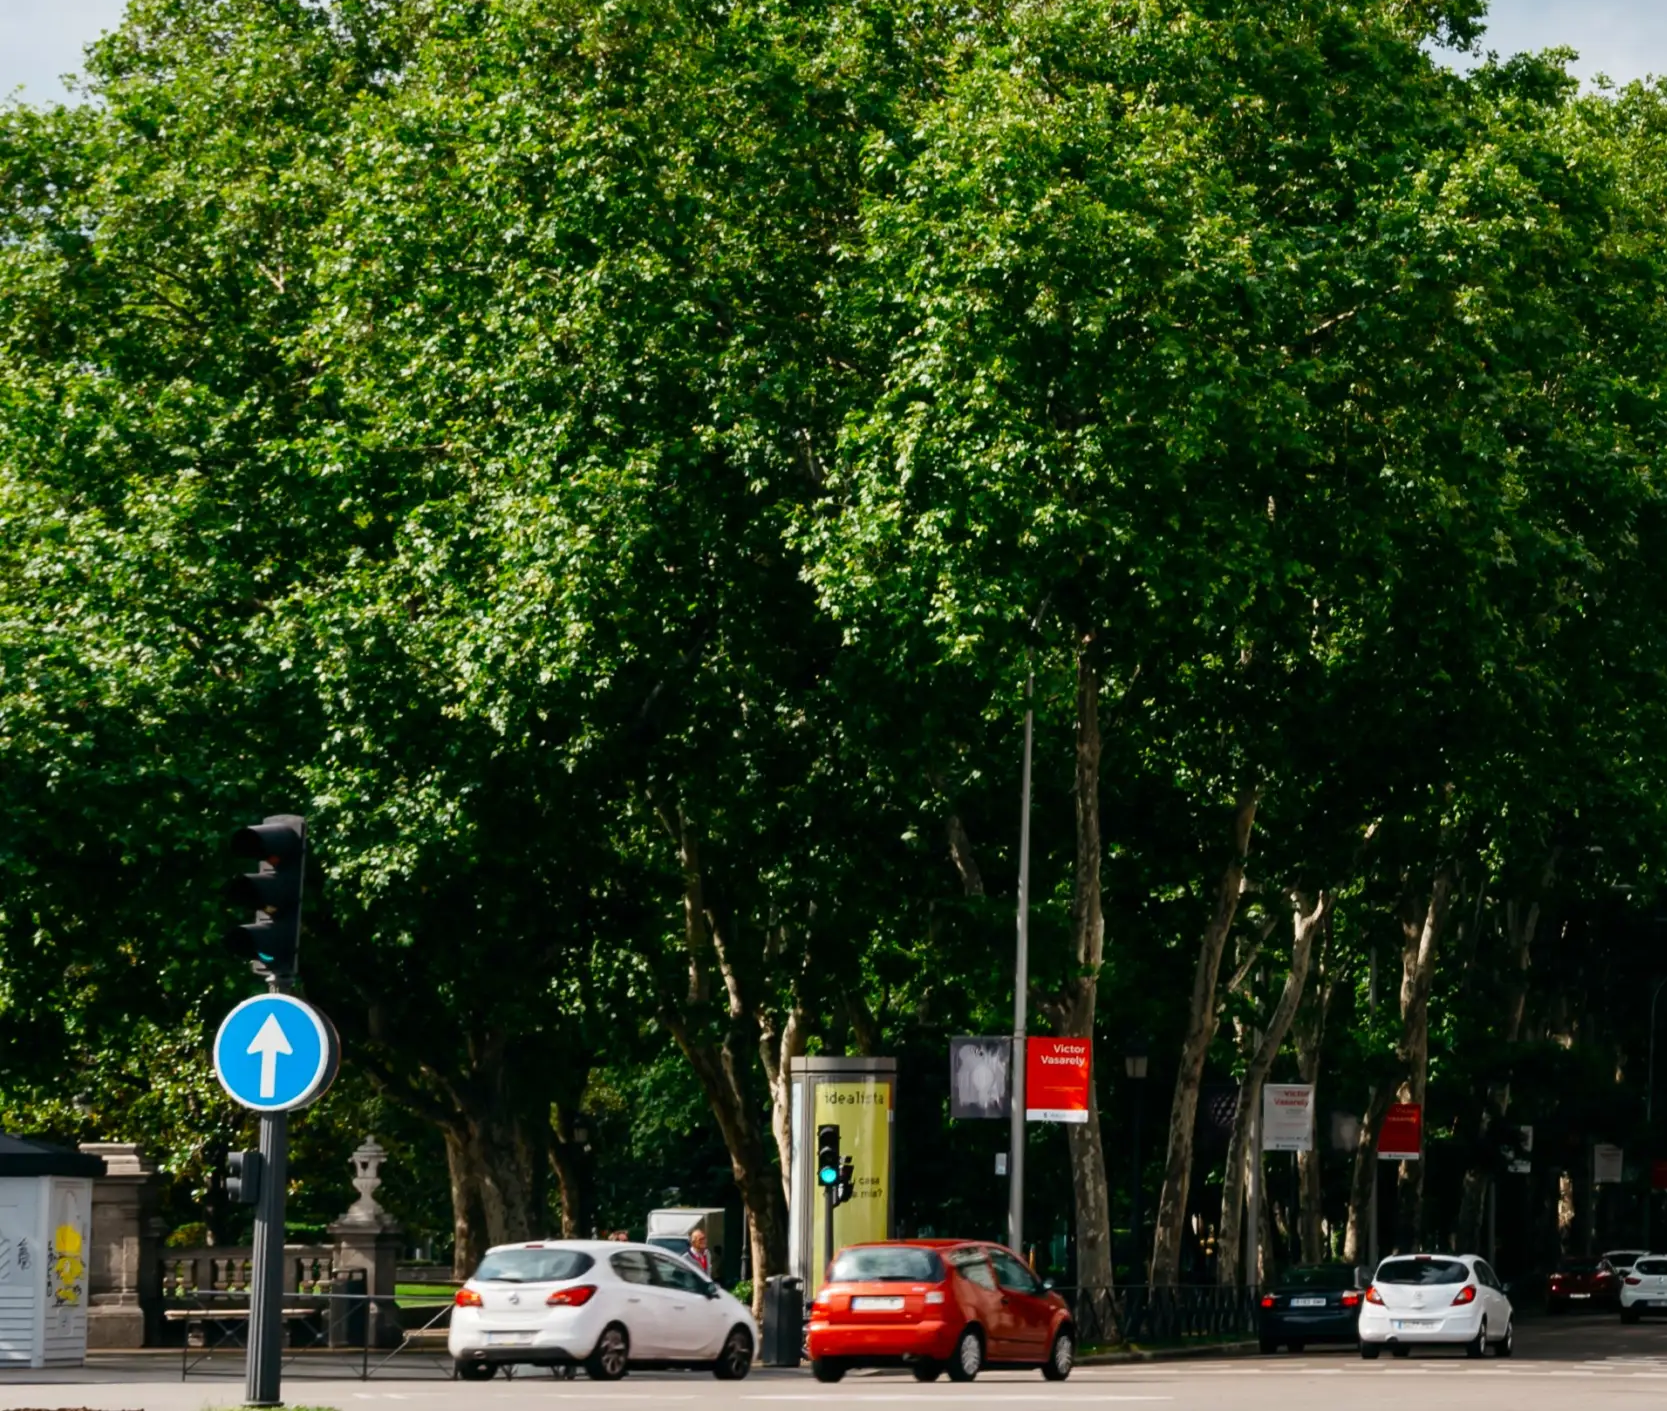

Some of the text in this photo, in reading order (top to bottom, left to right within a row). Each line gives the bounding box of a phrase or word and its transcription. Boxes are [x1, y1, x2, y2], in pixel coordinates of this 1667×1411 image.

[1053, 1044, 1085, 1054] Victor
[1040, 1055, 1085, 1068] Vasarely
[825, 1091, 884, 1105] idealista
